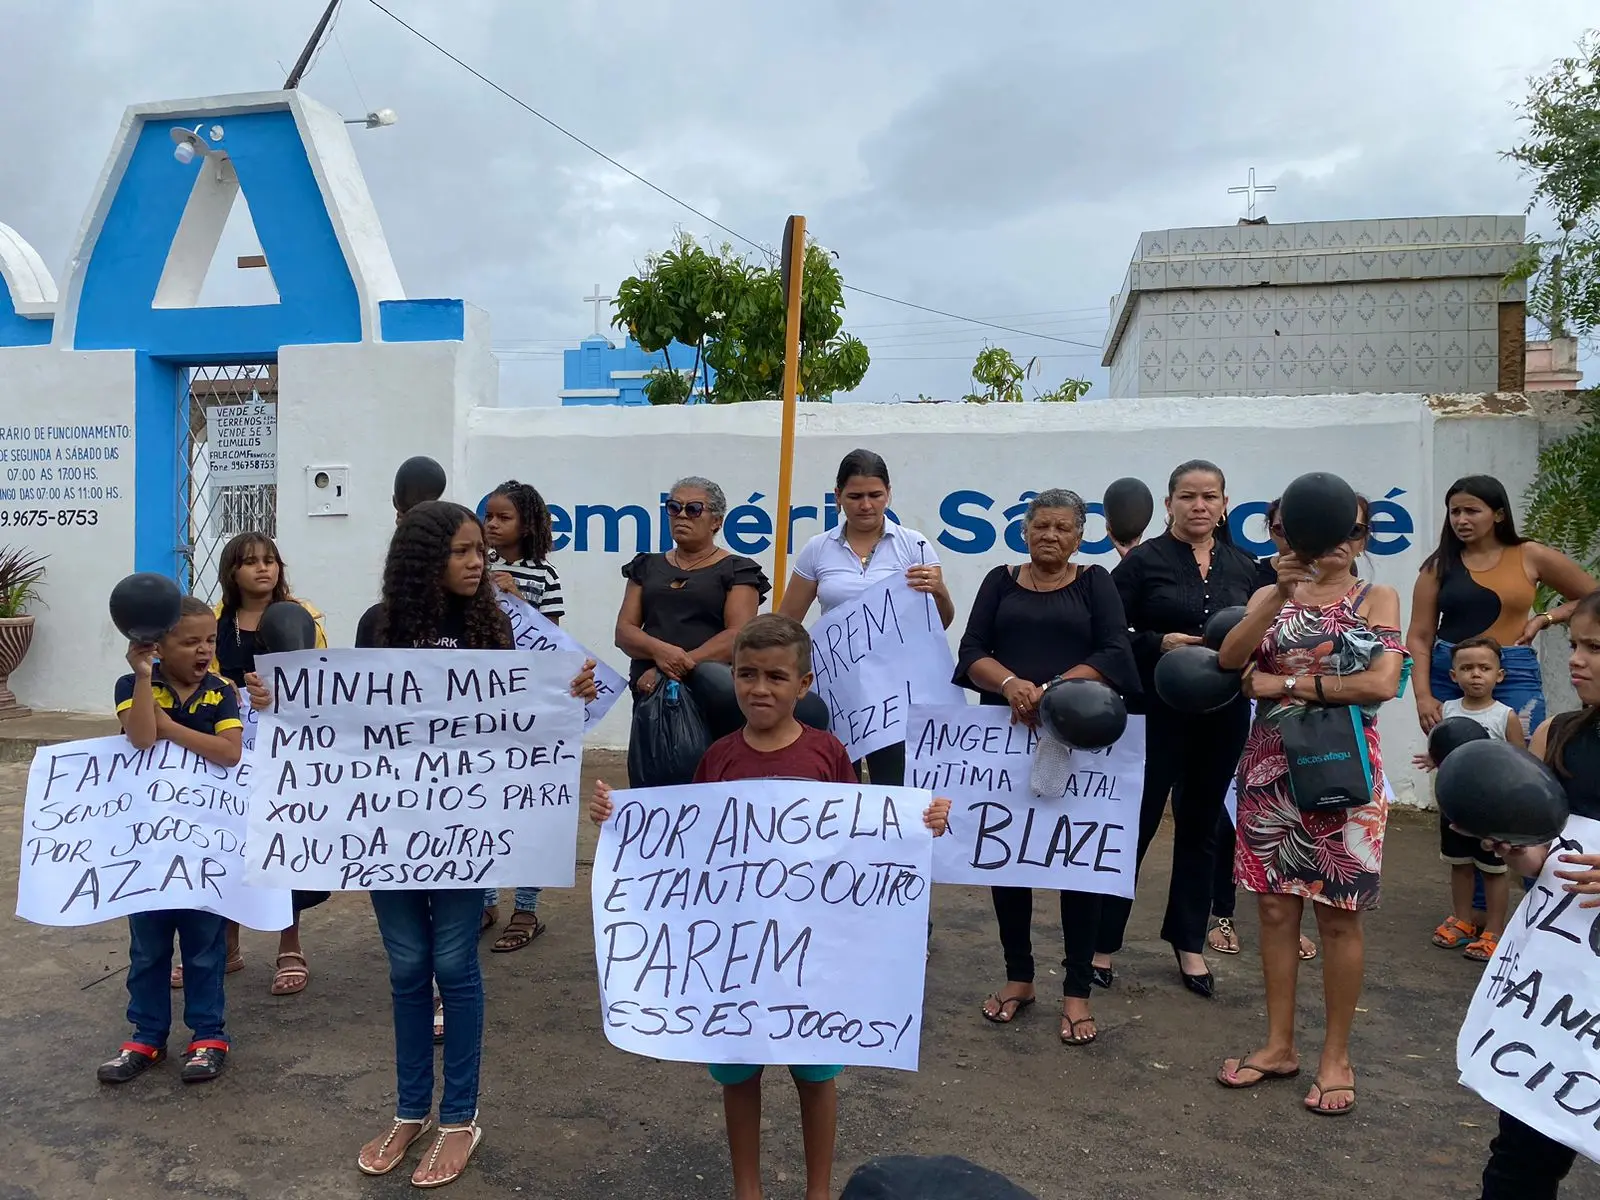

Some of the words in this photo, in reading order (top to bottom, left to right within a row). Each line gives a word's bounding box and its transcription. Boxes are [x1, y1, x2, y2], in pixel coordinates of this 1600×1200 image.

[34, 426, 45, 440] DE
[47, 424, 132, 439] FUNCIONAMENTO:
[216, 406, 249, 417] VENDE
[253, 405, 266, 415] SE
[217, 427, 246, 438] VENDE
[249, 427, 262, 437] SE
[265, 426, 272, 436] 3
[11, 448, 52, 461] SEGUNDA
[104, 446, 120, 460] DAS
[83, 467, 99, 480] HS.
[20, 487, 35, 500] DAS
[36, 487, 61, 500] 07:00
[78, 486, 103, 500] 11:00
[105, 486, 122, 500] HS.
[811, 588, 904, 696] AREM
[273, 656, 424, 714] MINHA
[446, 667, 530, 703] MAE
[271, 714, 336, 758] NÃO
[363, 721, 416, 750] ME
[429, 708, 537, 744] PEDIU
[414, 749, 496, 782] MAS
[1037, 769, 1121, 802] ATAL
[32, 792, 133, 831] SENDO
[266, 799, 329, 824] XOU
[346, 776, 488, 822] AUDIOS
[503, 783, 573, 809] PARA
[27, 836, 93, 866] POR
[110, 815, 210, 857] JOGOS
[262, 826, 388, 873] AJUDA
[405, 824, 514, 861] OUTRAS
[614, 800, 700, 873] POR
[706, 791, 903, 865] ANGELA
[967, 801, 1125, 874] BLAZE
[60, 854, 227, 914] AZAR
[603, 918, 812, 999] PAREM
[606, 1000, 760, 1037] ESSES
[768, 1003, 913, 1053] JOGOS!
